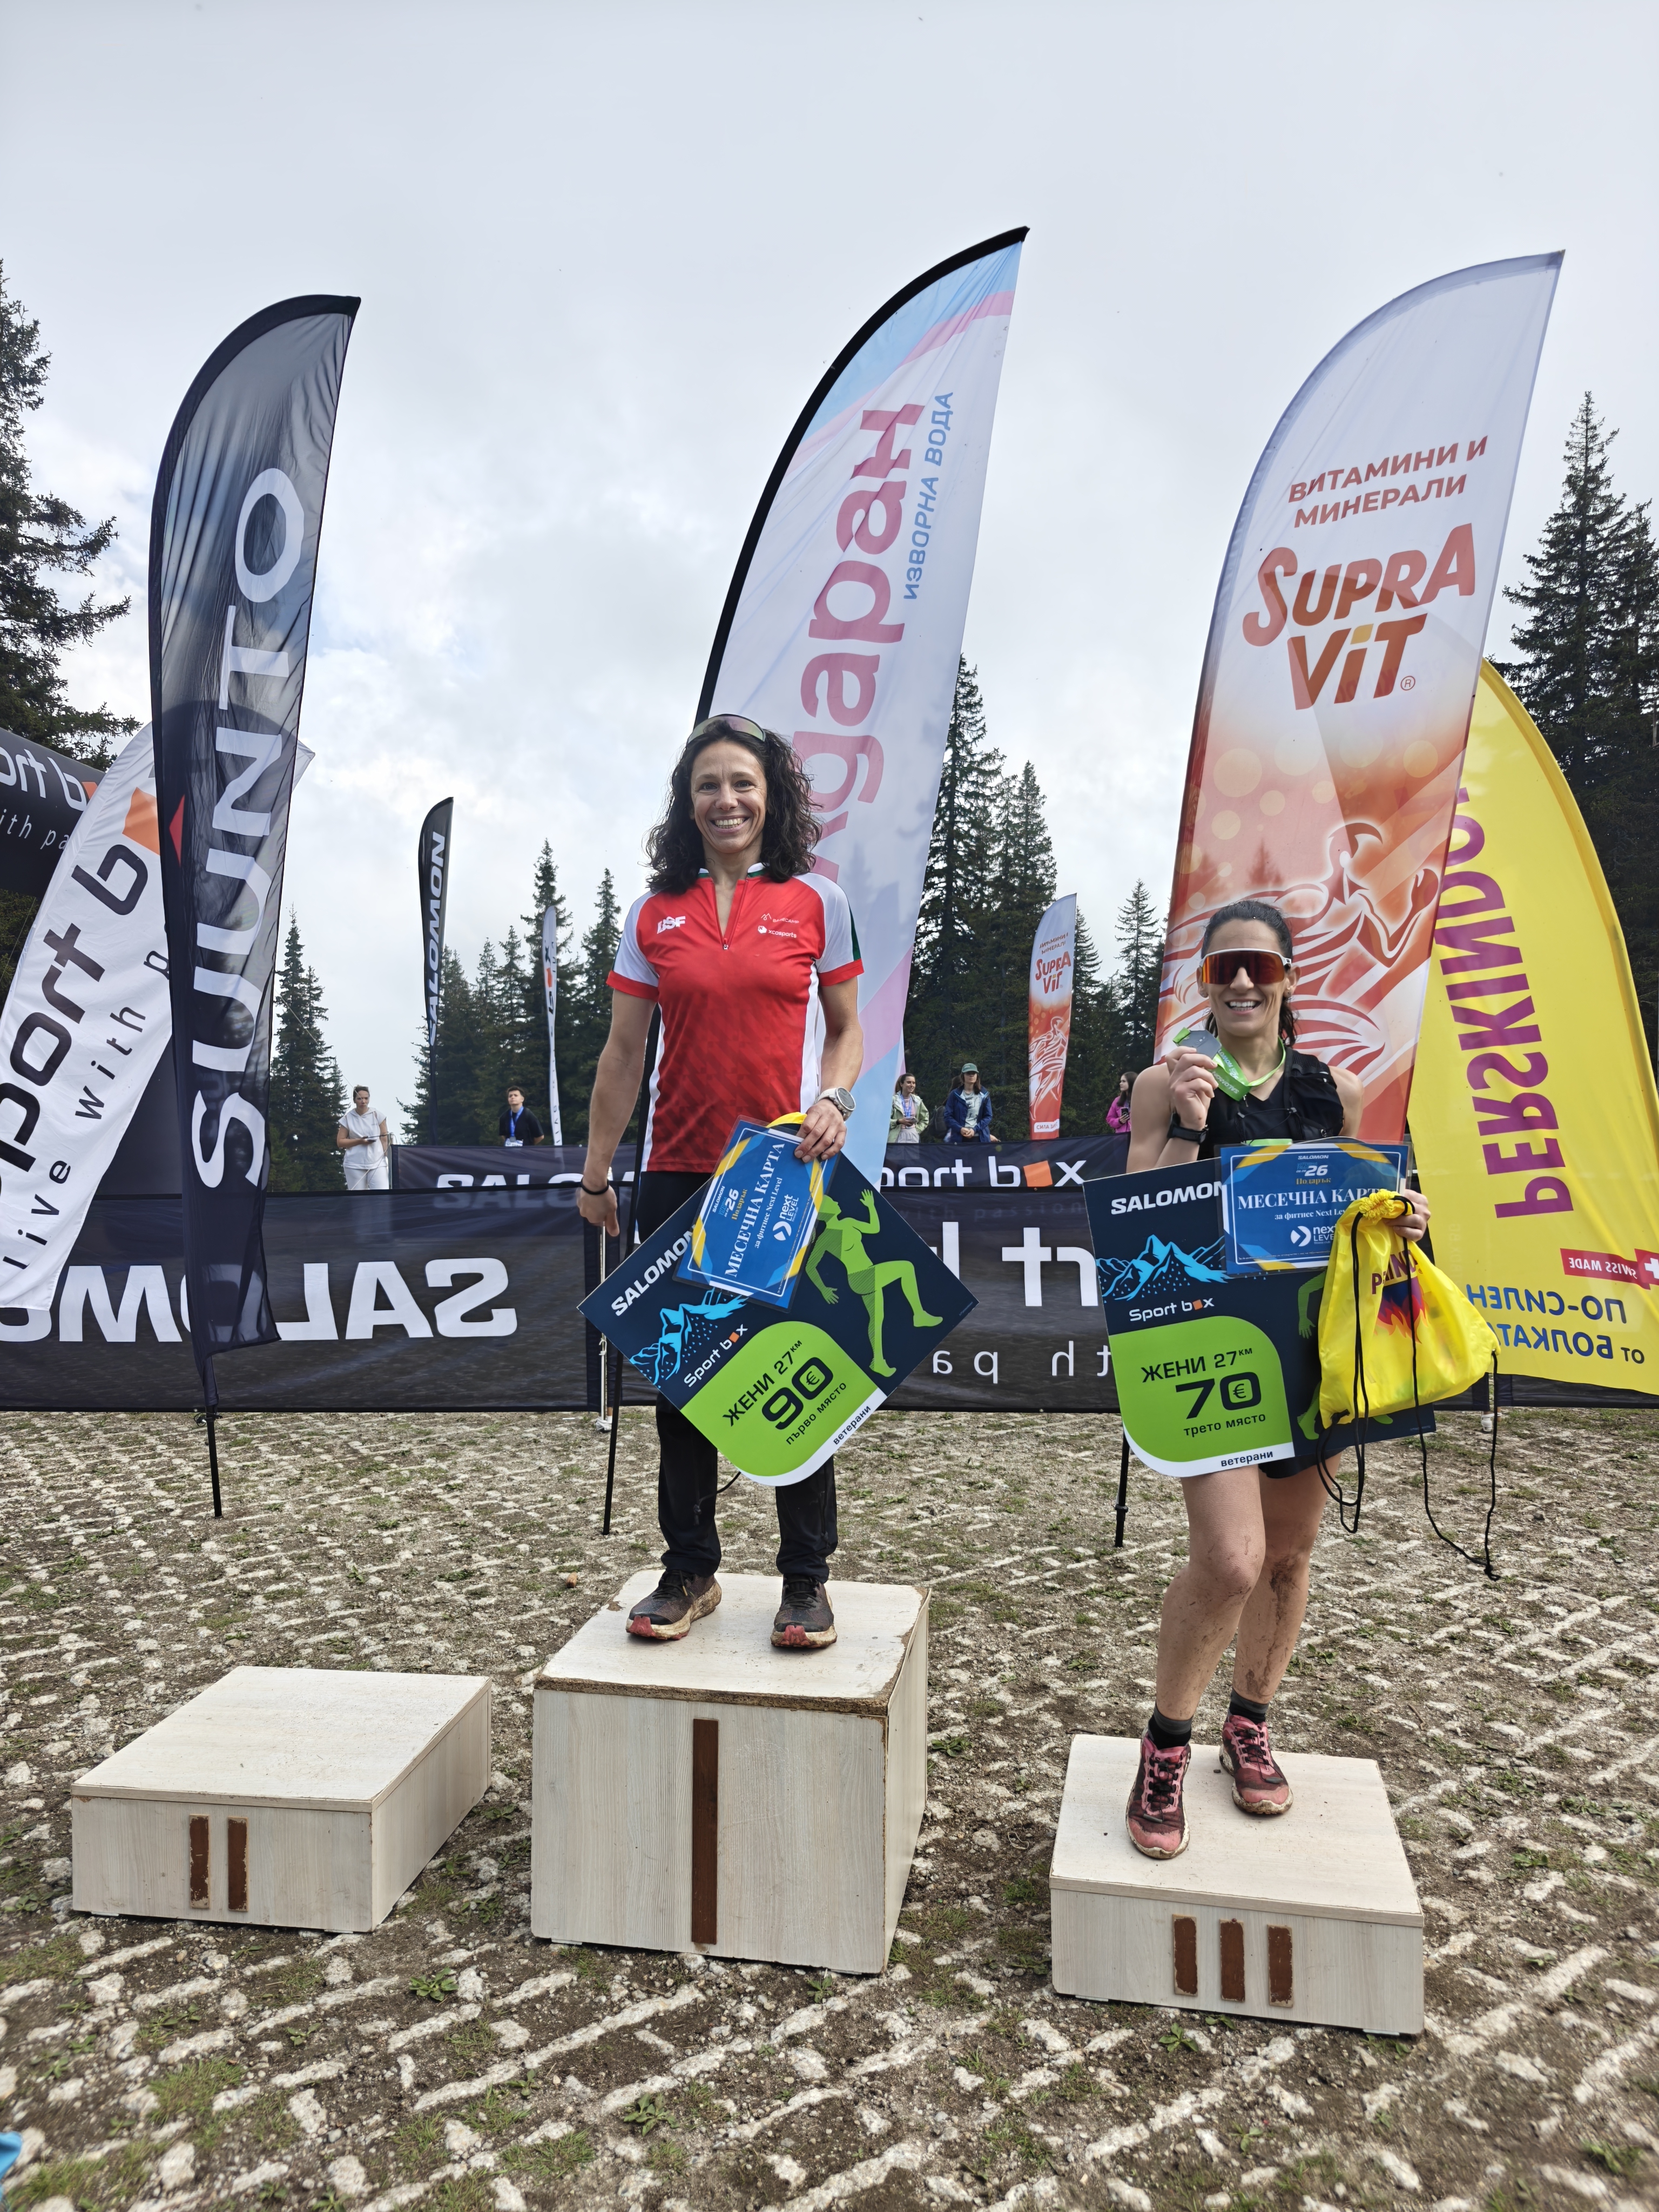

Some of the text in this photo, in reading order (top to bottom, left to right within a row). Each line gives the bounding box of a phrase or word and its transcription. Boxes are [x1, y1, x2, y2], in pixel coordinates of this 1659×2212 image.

[1288, 435, 1488, 503] ВИТАМИНИ И
[904, 392, 953, 599] ИЗВОРНА ВОДА
[1294, 474, 1467, 528] МИНЕРАЛИ
[1242, 523, 1475, 647] SUPRA
[192, 468, 305, 1188] SUUNTO
[428, 832, 445, 1046] SALOMON
[1035, 951, 1071, 980] SUPRA
[0, 922, 105, 1185] port
[3, 1007, 146, 1269] live with
[1305, 1165, 1328, 1176] 26
[712, 1185, 725, 1212] SALOMON
[725, 1189, 739, 1211] 26
[725, 1143, 785, 1278] МЕСЕЧНА КАРТА
[765, 1195, 776, 1212] Next
[771, 1177, 783, 1196] Level
[779, 1193, 793, 1219] next
[786, 1197, 799, 1222] LEVEL
[1238, 1188, 1381, 1210] МЕСЕЧНА КАРТ
[1284, 1211, 1313, 1220] фитнес
[1129, 1303, 1177, 1321] Sport
[684, 1348, 721, 1387] Sport
[1141, 1356, 1206, 1383] ЖЕНИ
[723, 1373, 774, 1427] ЖЕНИ
[786, 1382, 847, 1445] първо място
[833, 1406, 871, 1445] ветерани
[1183, 1414, 1266, 1438] трето място
[1221, 1451, 1273, 1467] ветерани
